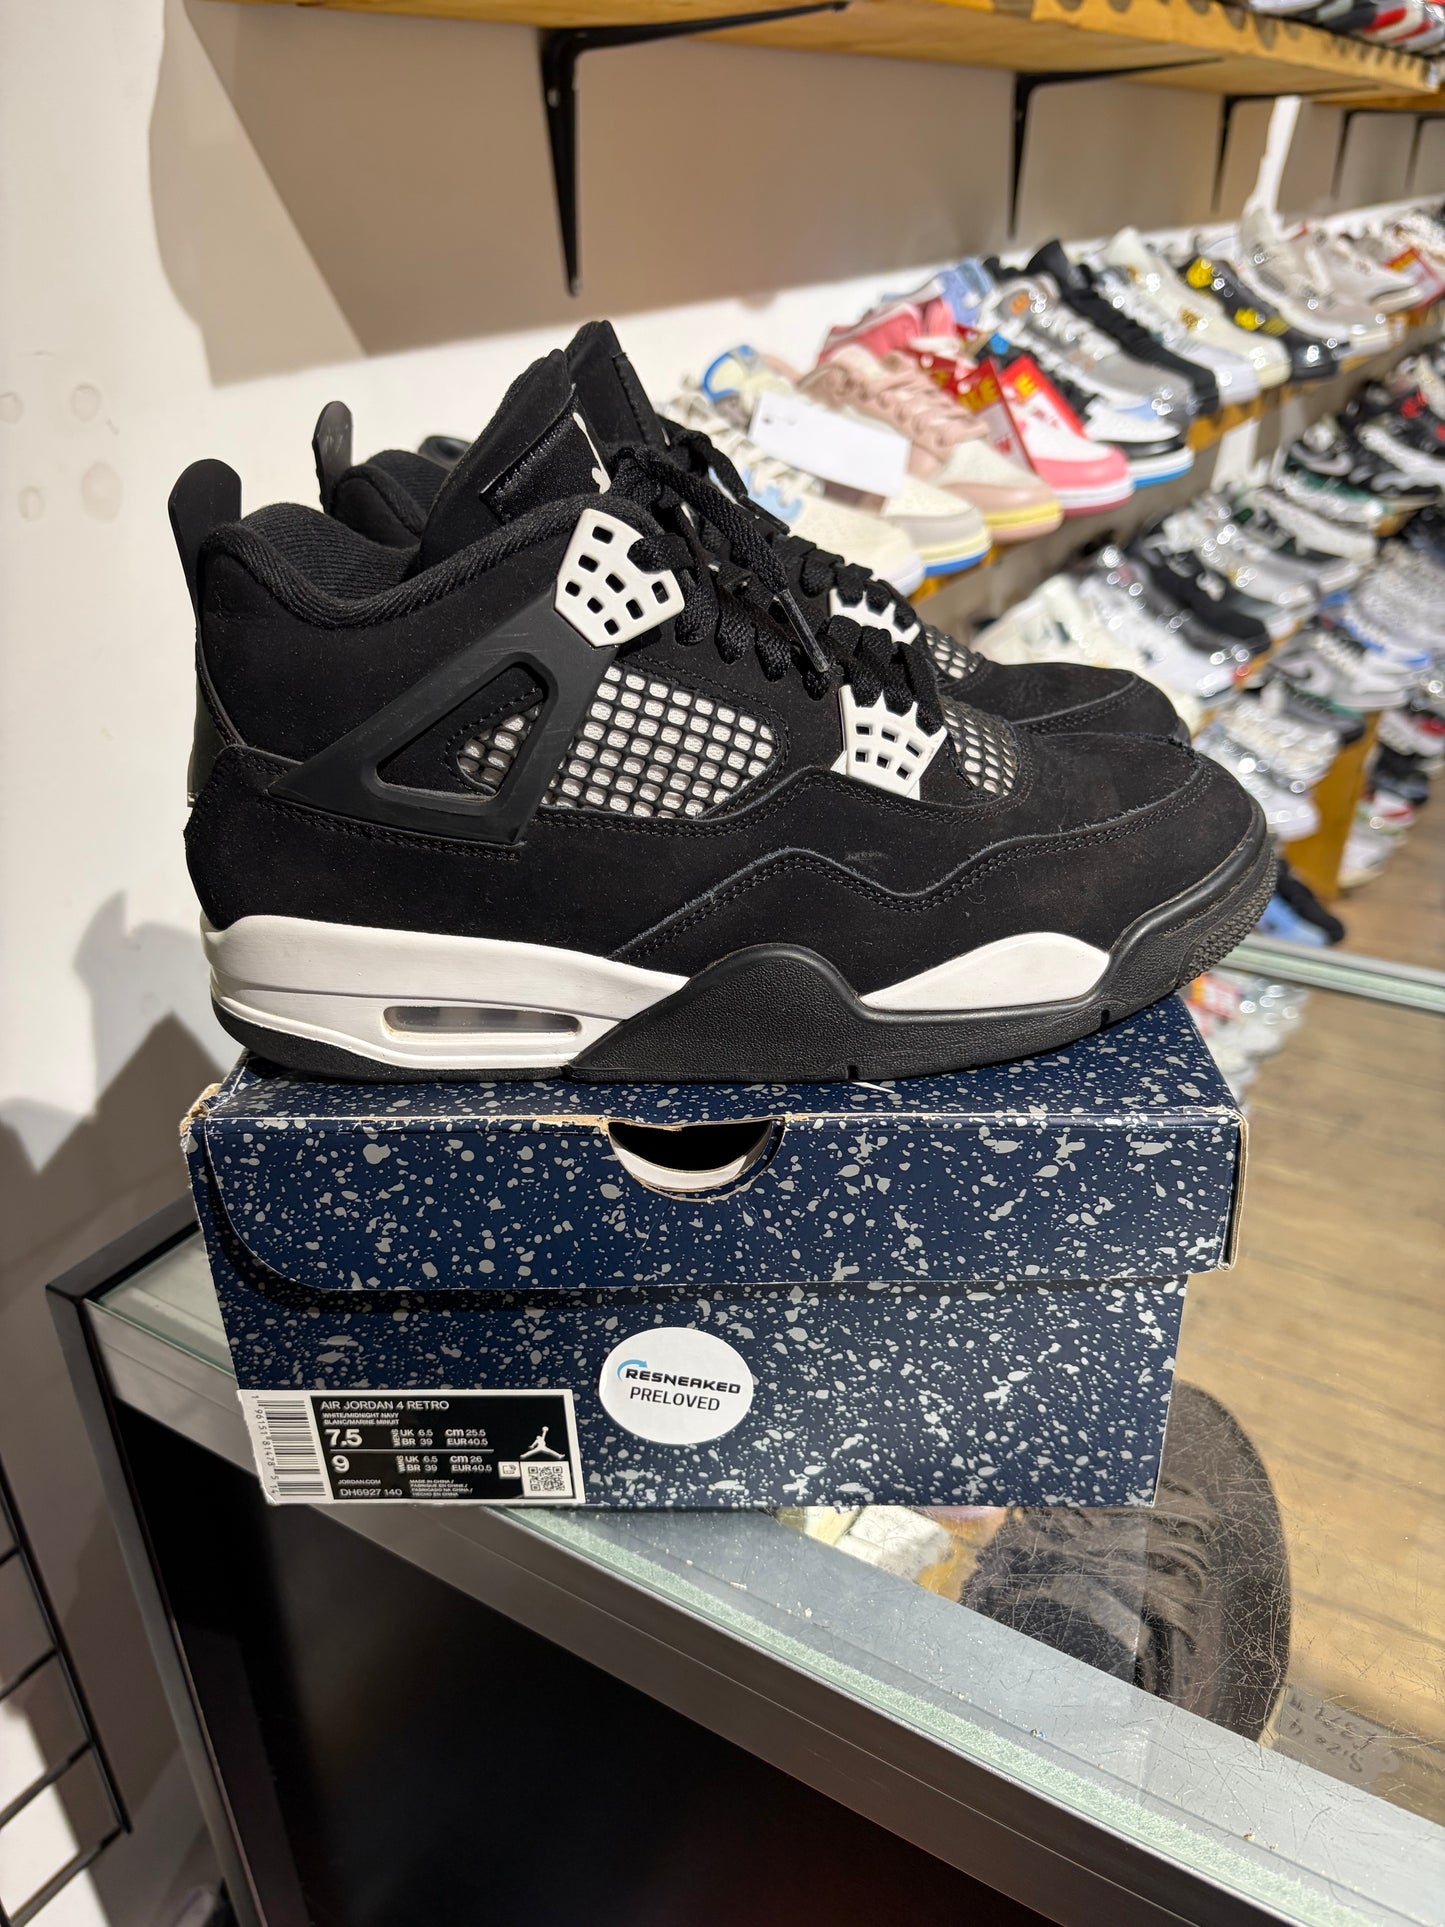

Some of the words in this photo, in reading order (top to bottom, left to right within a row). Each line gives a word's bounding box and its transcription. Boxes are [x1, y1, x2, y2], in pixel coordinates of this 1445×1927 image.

[625, 1368, 741, 1394] RESNEAKED
[321, 1401, 341, 1410] AIR
[343, 1401, 394, 1410] JORDAN
[396, 1401, 404, 1410] 4
[406, 1401, 450, 1410] RETRO
[629, 1386, 720, 1411] PRELOVED
[325, 1428, 363, 1447] 7.5
[401, 1438, 416, 1446] BR
[420, 1438, 433, 1446] 39
[332, 1455, 350, 1473] 9
